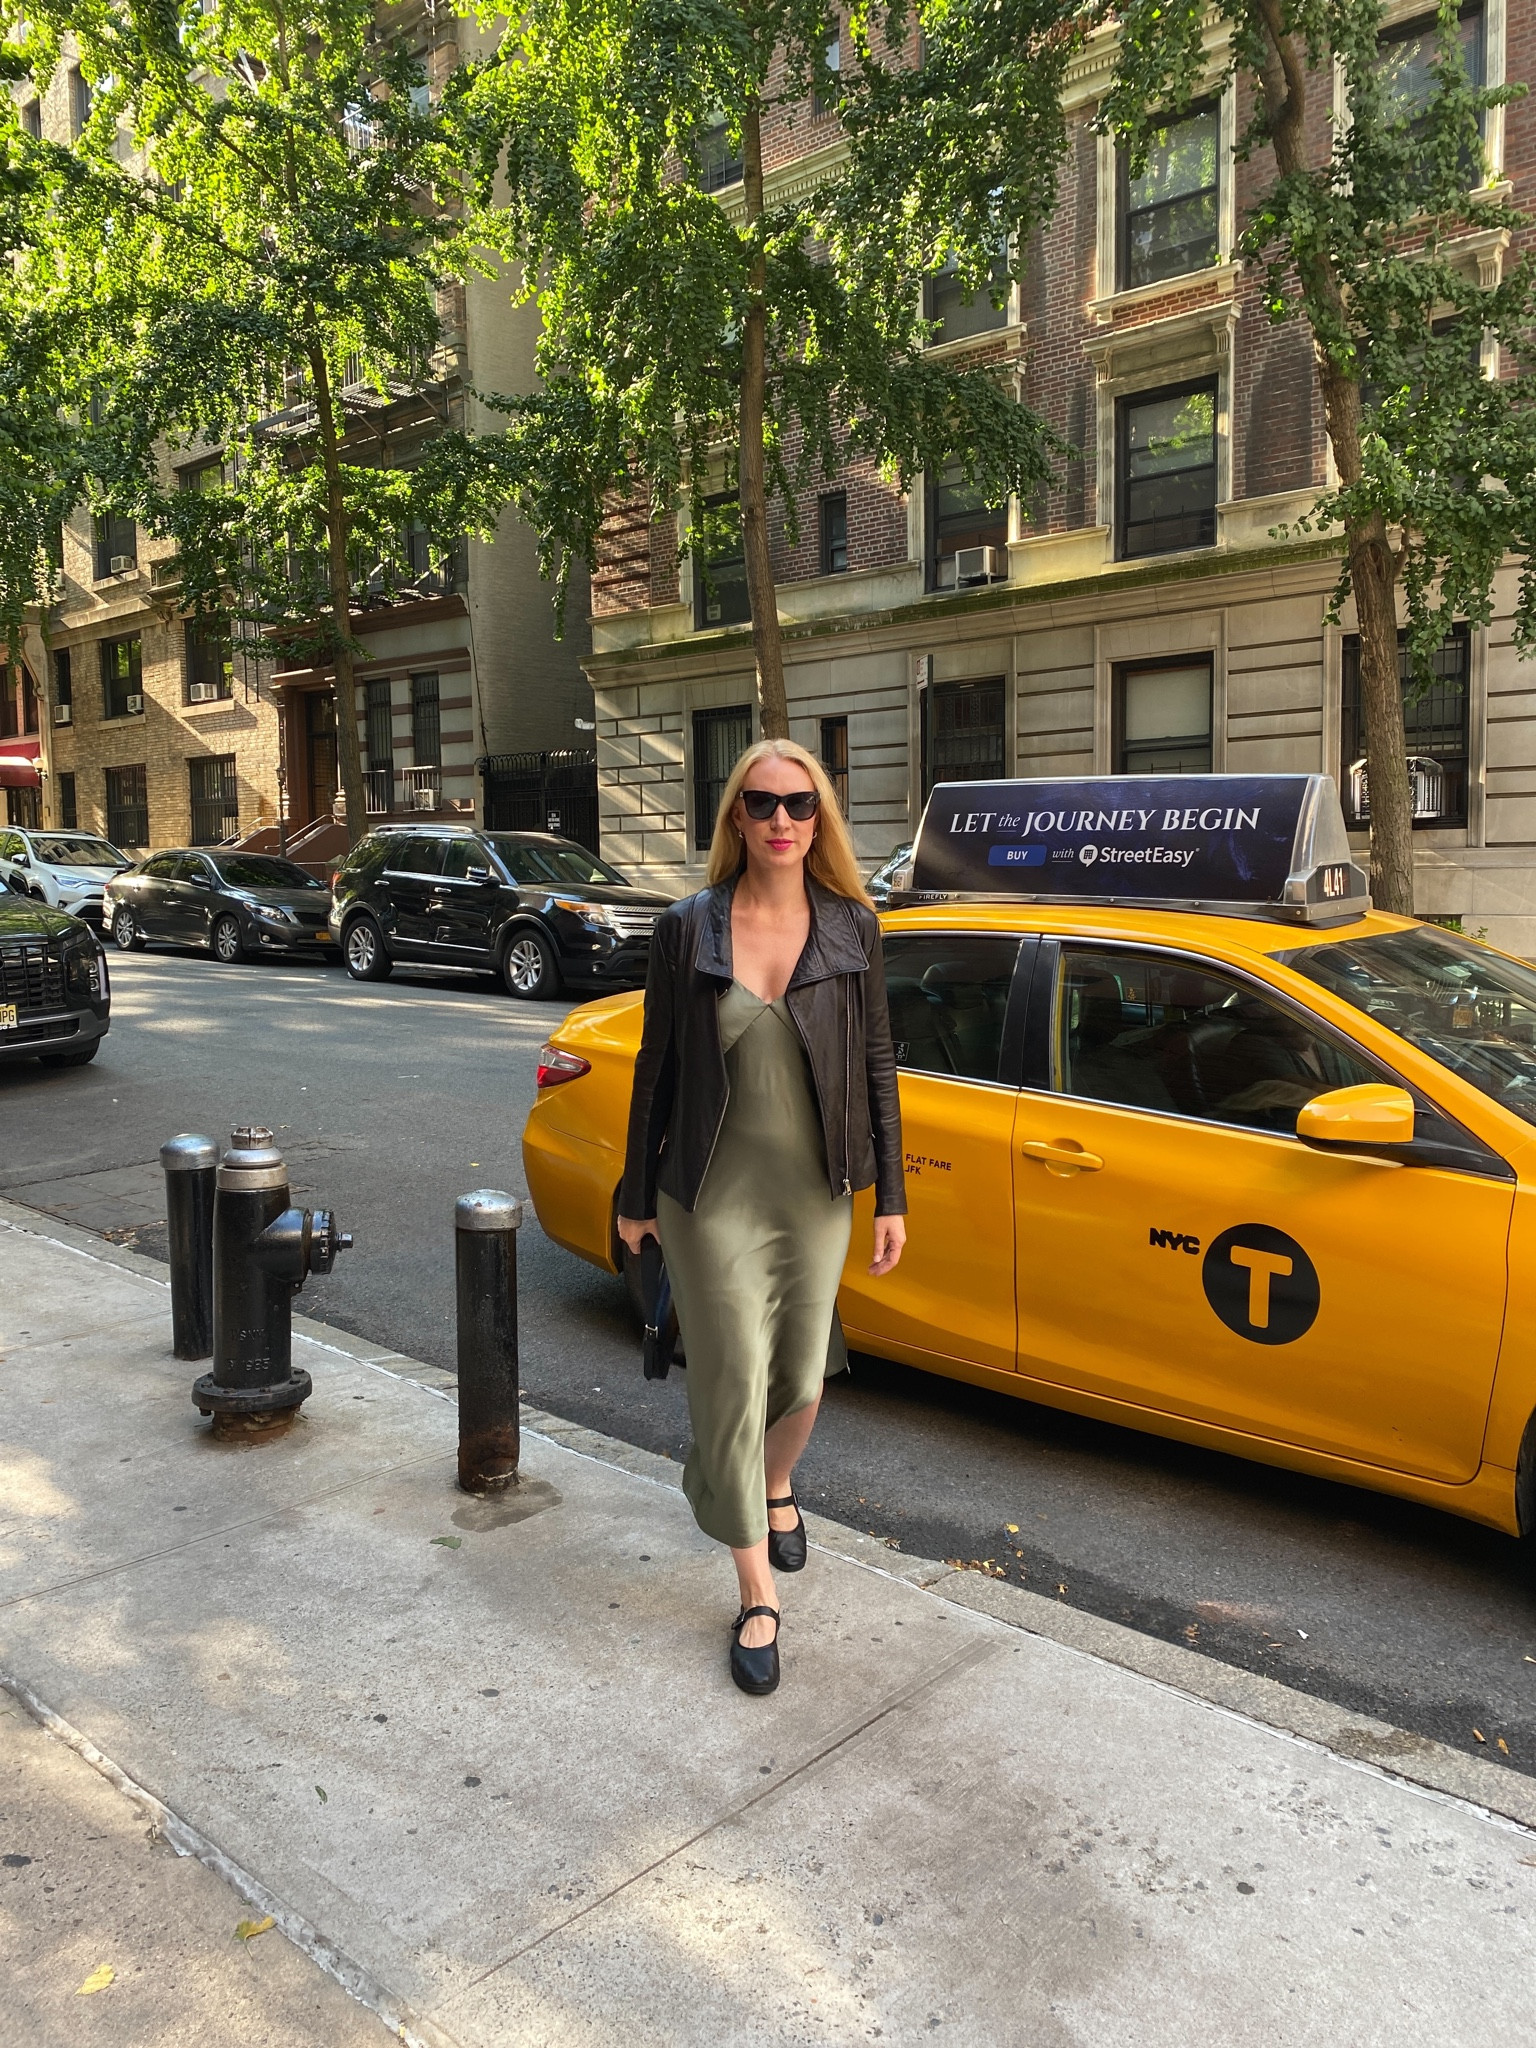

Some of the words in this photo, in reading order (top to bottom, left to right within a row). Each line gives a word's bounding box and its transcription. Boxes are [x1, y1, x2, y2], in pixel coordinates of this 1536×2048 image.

[949, 812, 997, 833] LET
[998, 813, 1021, 828] the
[1020, 809, 1157, 838] JOURNEY
[1160, 807, 1262, 832] BEGIN
[1006, 850, 1029, 861] BUY
[1052, 848, 1075, 859] with
[1099, 846, 1195, 868] StreetEasy
[1323, 867, 1344, 897] 4L41
[0, 1009, 15, 1023] PG
[904, 1164, 921, 1175] JFK
[905, 1153, 927, 1166] FLAT
[928, 1158, 952, 1171] FARE
[1149, 1227, 1201, 1256] NYC
[1230, 1244, 1294, 1329] T
